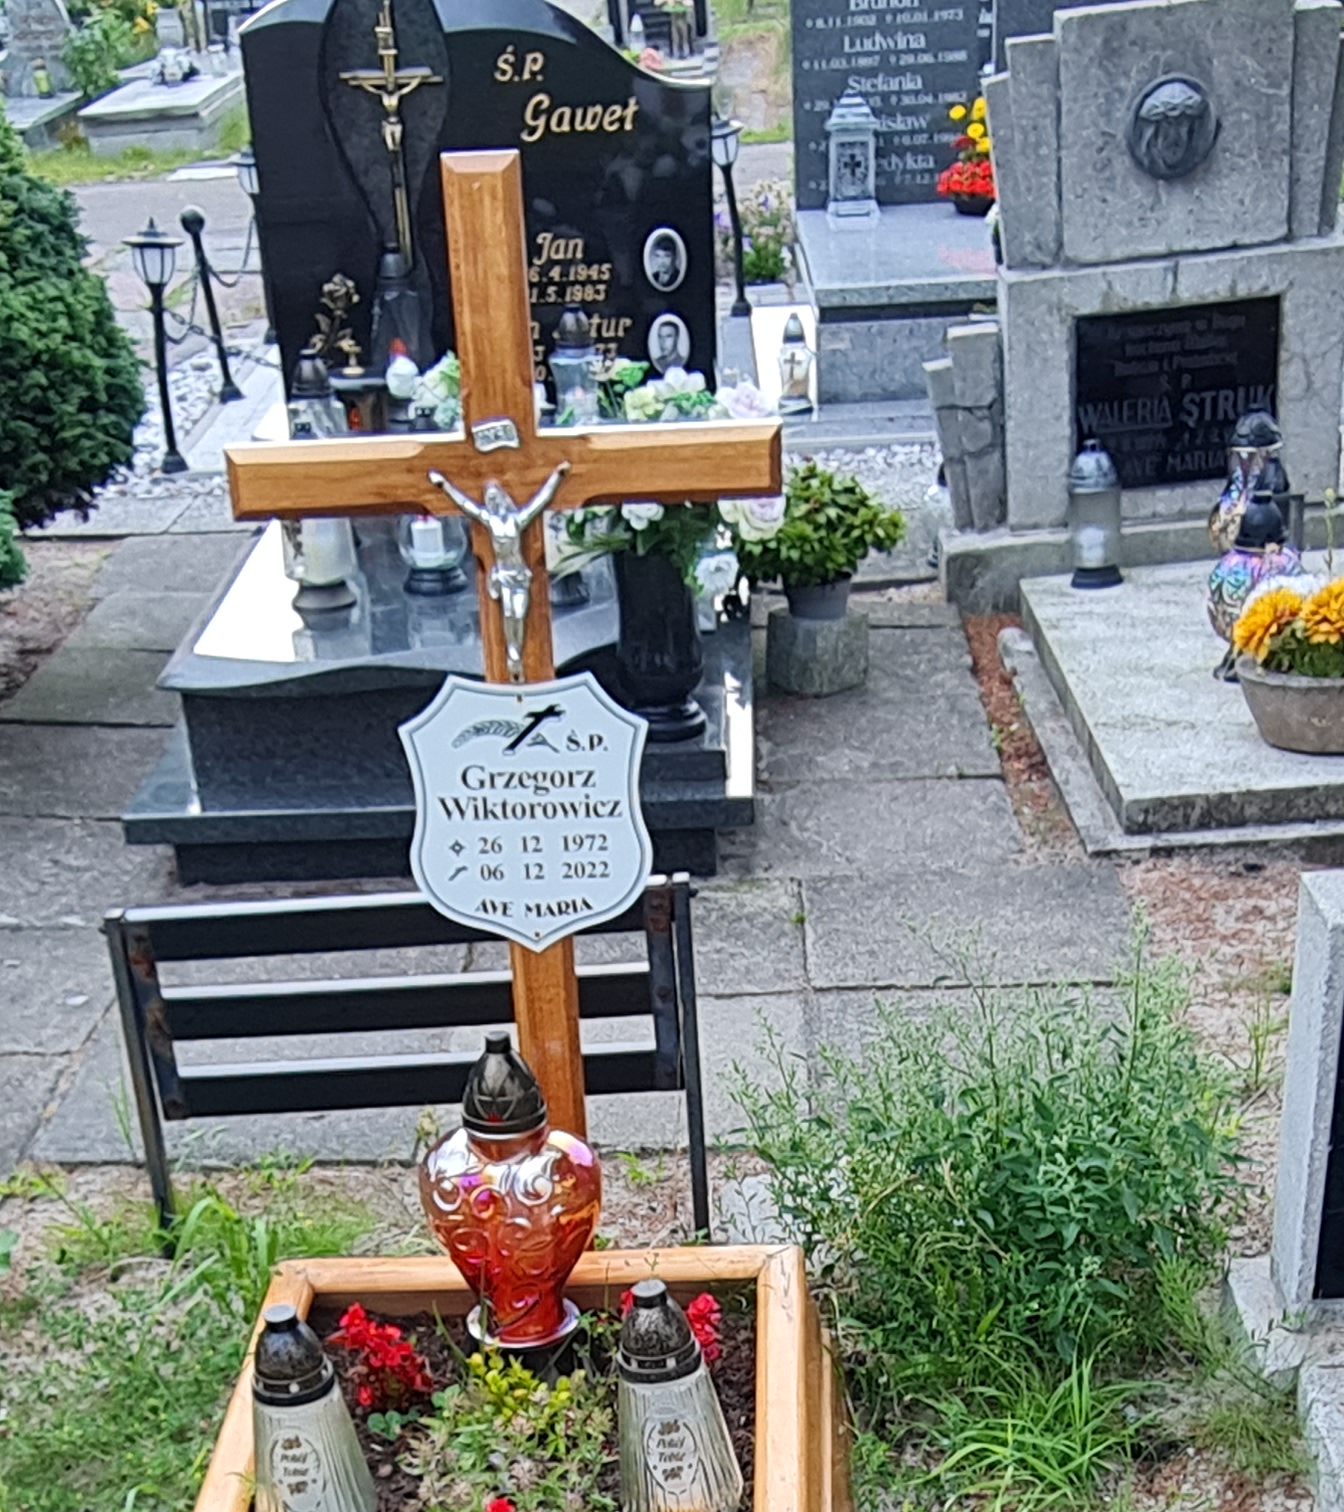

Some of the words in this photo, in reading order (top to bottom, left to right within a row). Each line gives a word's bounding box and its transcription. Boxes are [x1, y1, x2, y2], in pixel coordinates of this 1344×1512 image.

[843, 30, 926, 53] Ludwina
[848, 71, 923, 93] Stefania
[532, 232, 584, 265] Jan
[1078, 397, 1174, 434] WALERIA
[461, 765, 596, 796] Grzegorz
[438, 794, 623, 821] Wiktorowicz
[478, 836, 503, 854] 26
[521, 835, 543, 853] 12
[562, 834, 609, 852] 1972
[480, 863, 504, 881] 06
[524, 862, 545, 880] 12
[562, 861, 610, 879] 2022
[475, 898, 514, 918] AVE
[524, 897, 594, 918] MARIA
